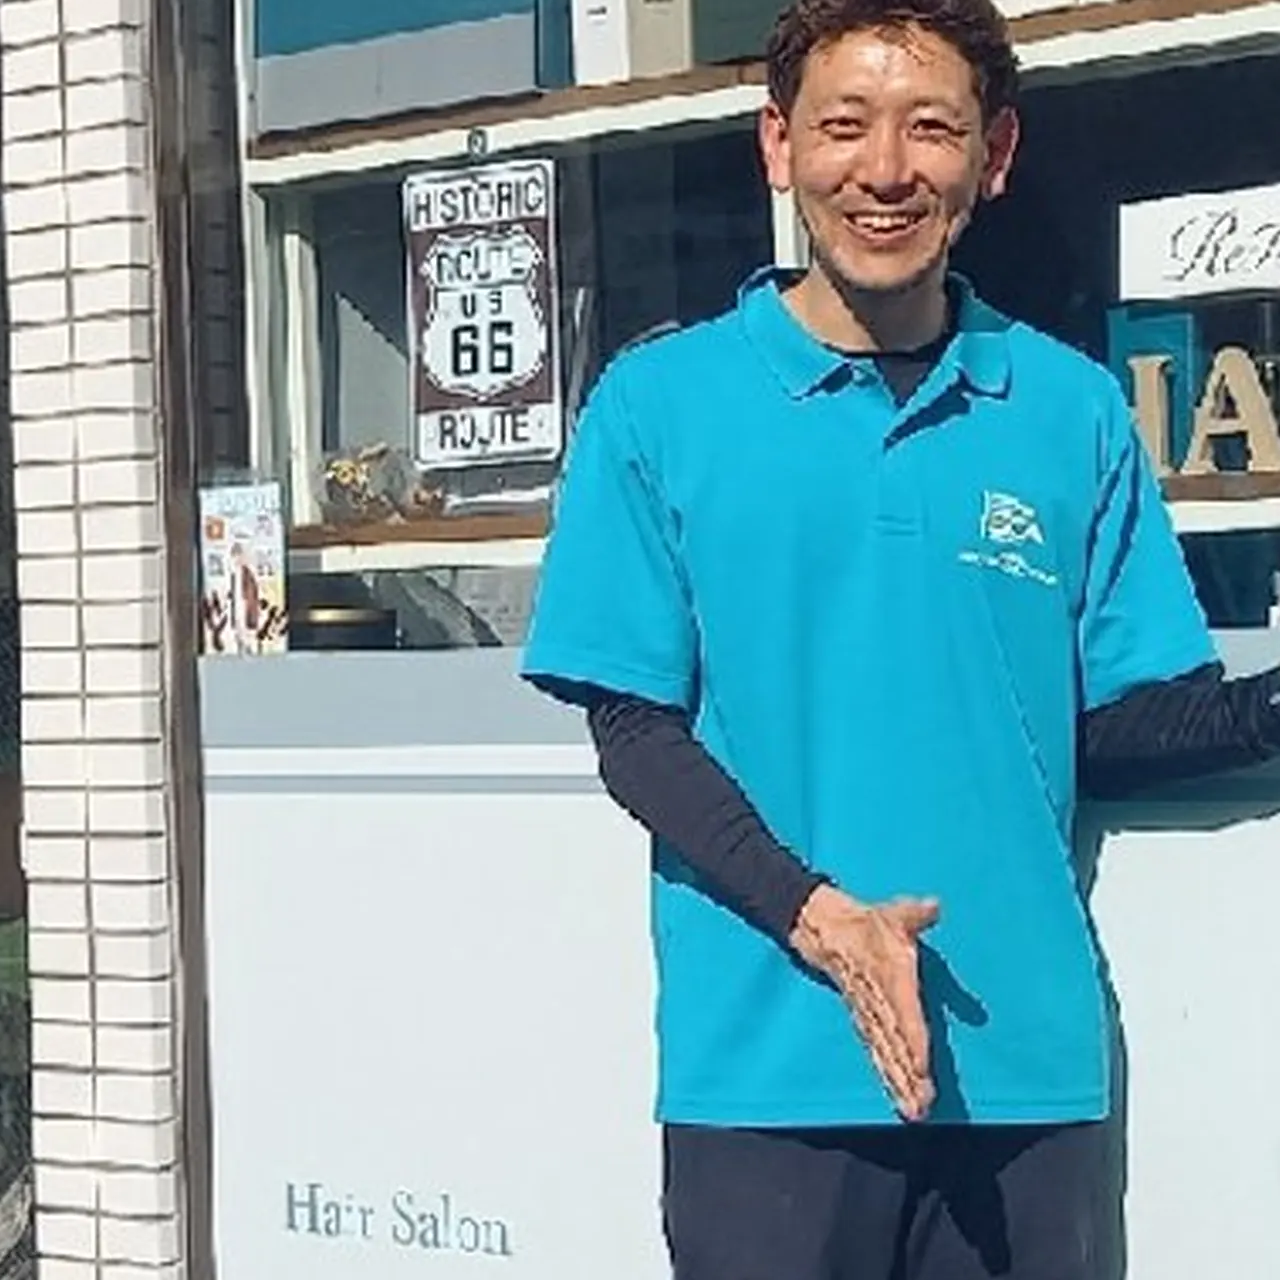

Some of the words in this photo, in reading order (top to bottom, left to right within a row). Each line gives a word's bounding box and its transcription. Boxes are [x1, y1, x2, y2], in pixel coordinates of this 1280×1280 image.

[413, 173, 543, 226] HISTORIC
[451, 320, 514, 377] 66
[438, 408, 531, 450] ROUTE
[285, 1182, 375, 1239] Hair
[391, 1189, 514, 1257] Salon
